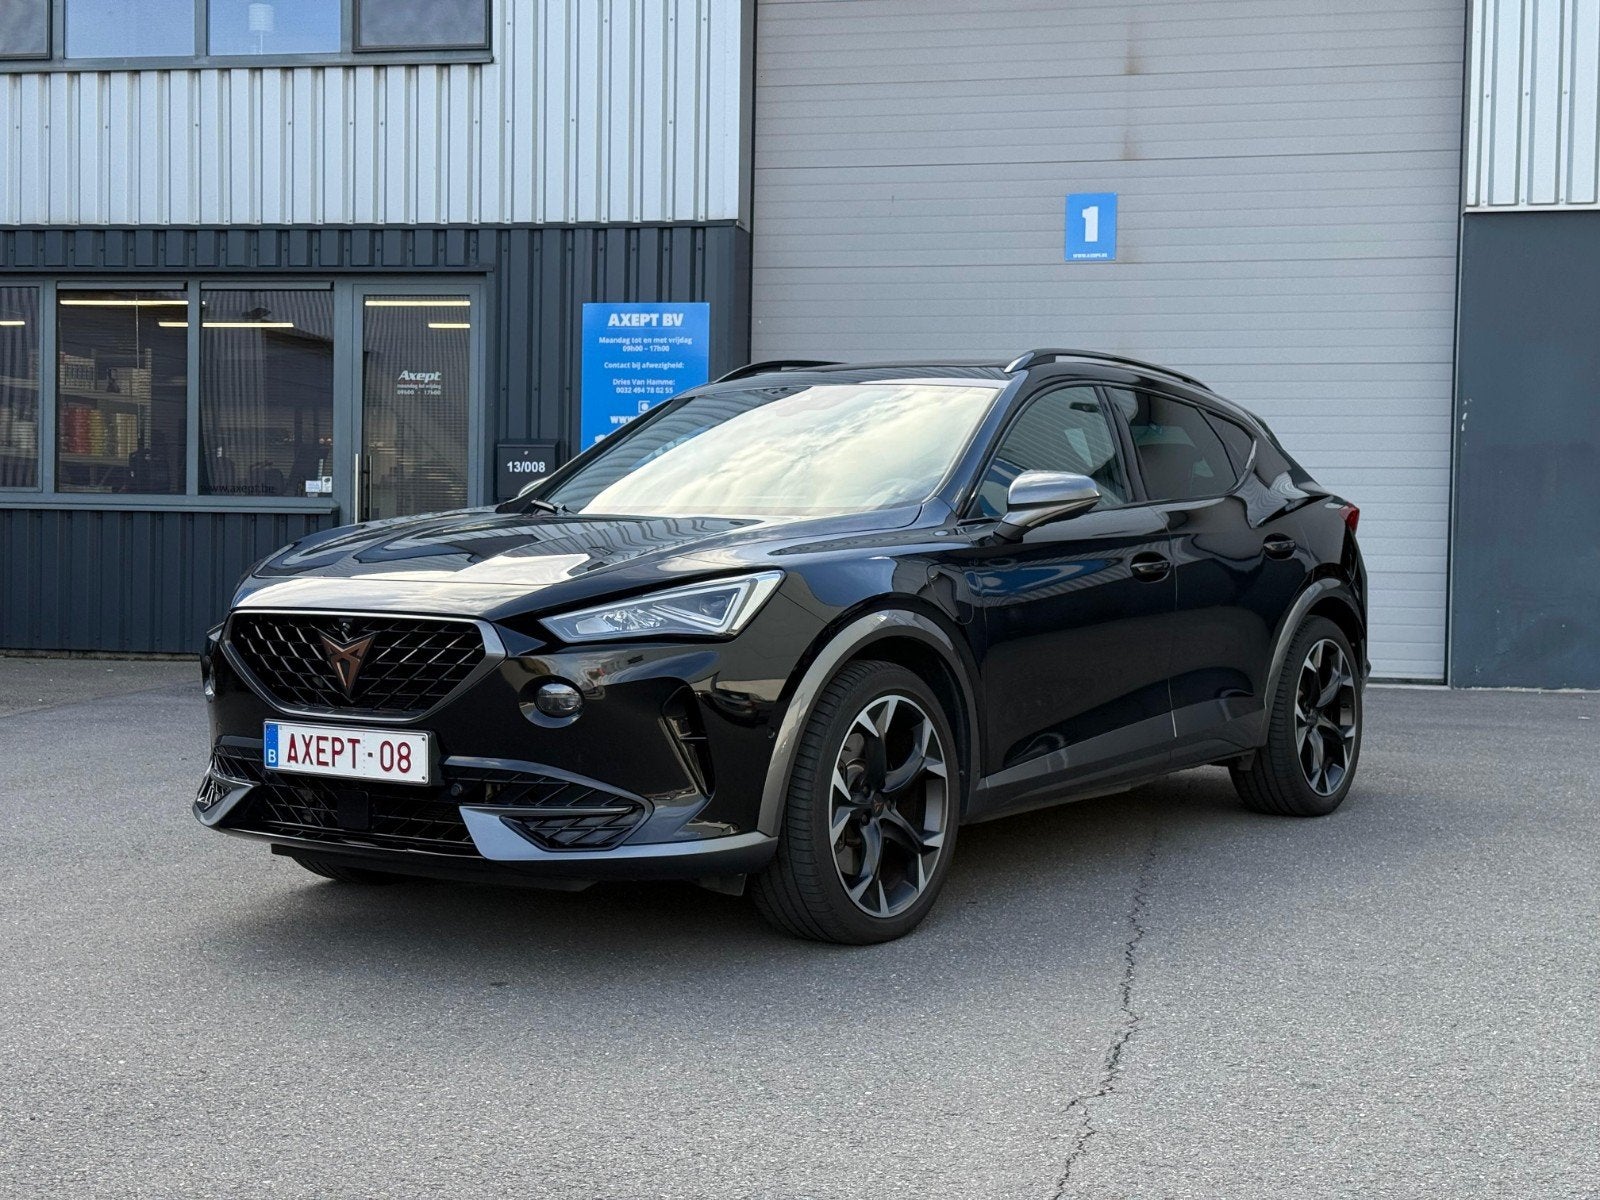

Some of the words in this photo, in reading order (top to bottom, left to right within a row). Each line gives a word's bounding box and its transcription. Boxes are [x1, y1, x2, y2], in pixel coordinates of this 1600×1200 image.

[1082, 206, 1099, 243] 1
[608, 313, 659, 327] AXEPT
[662, 313, 684, 327] BV
[599, 337, 630, 345] Maandag
[668, 337, 693, 345] vrijdag
[632, 362, 641, 370] bij
[398, 370, 442, 383] Axept
[507, 461, 546, 473] 13/008
[268, 749, 277, 763] B
